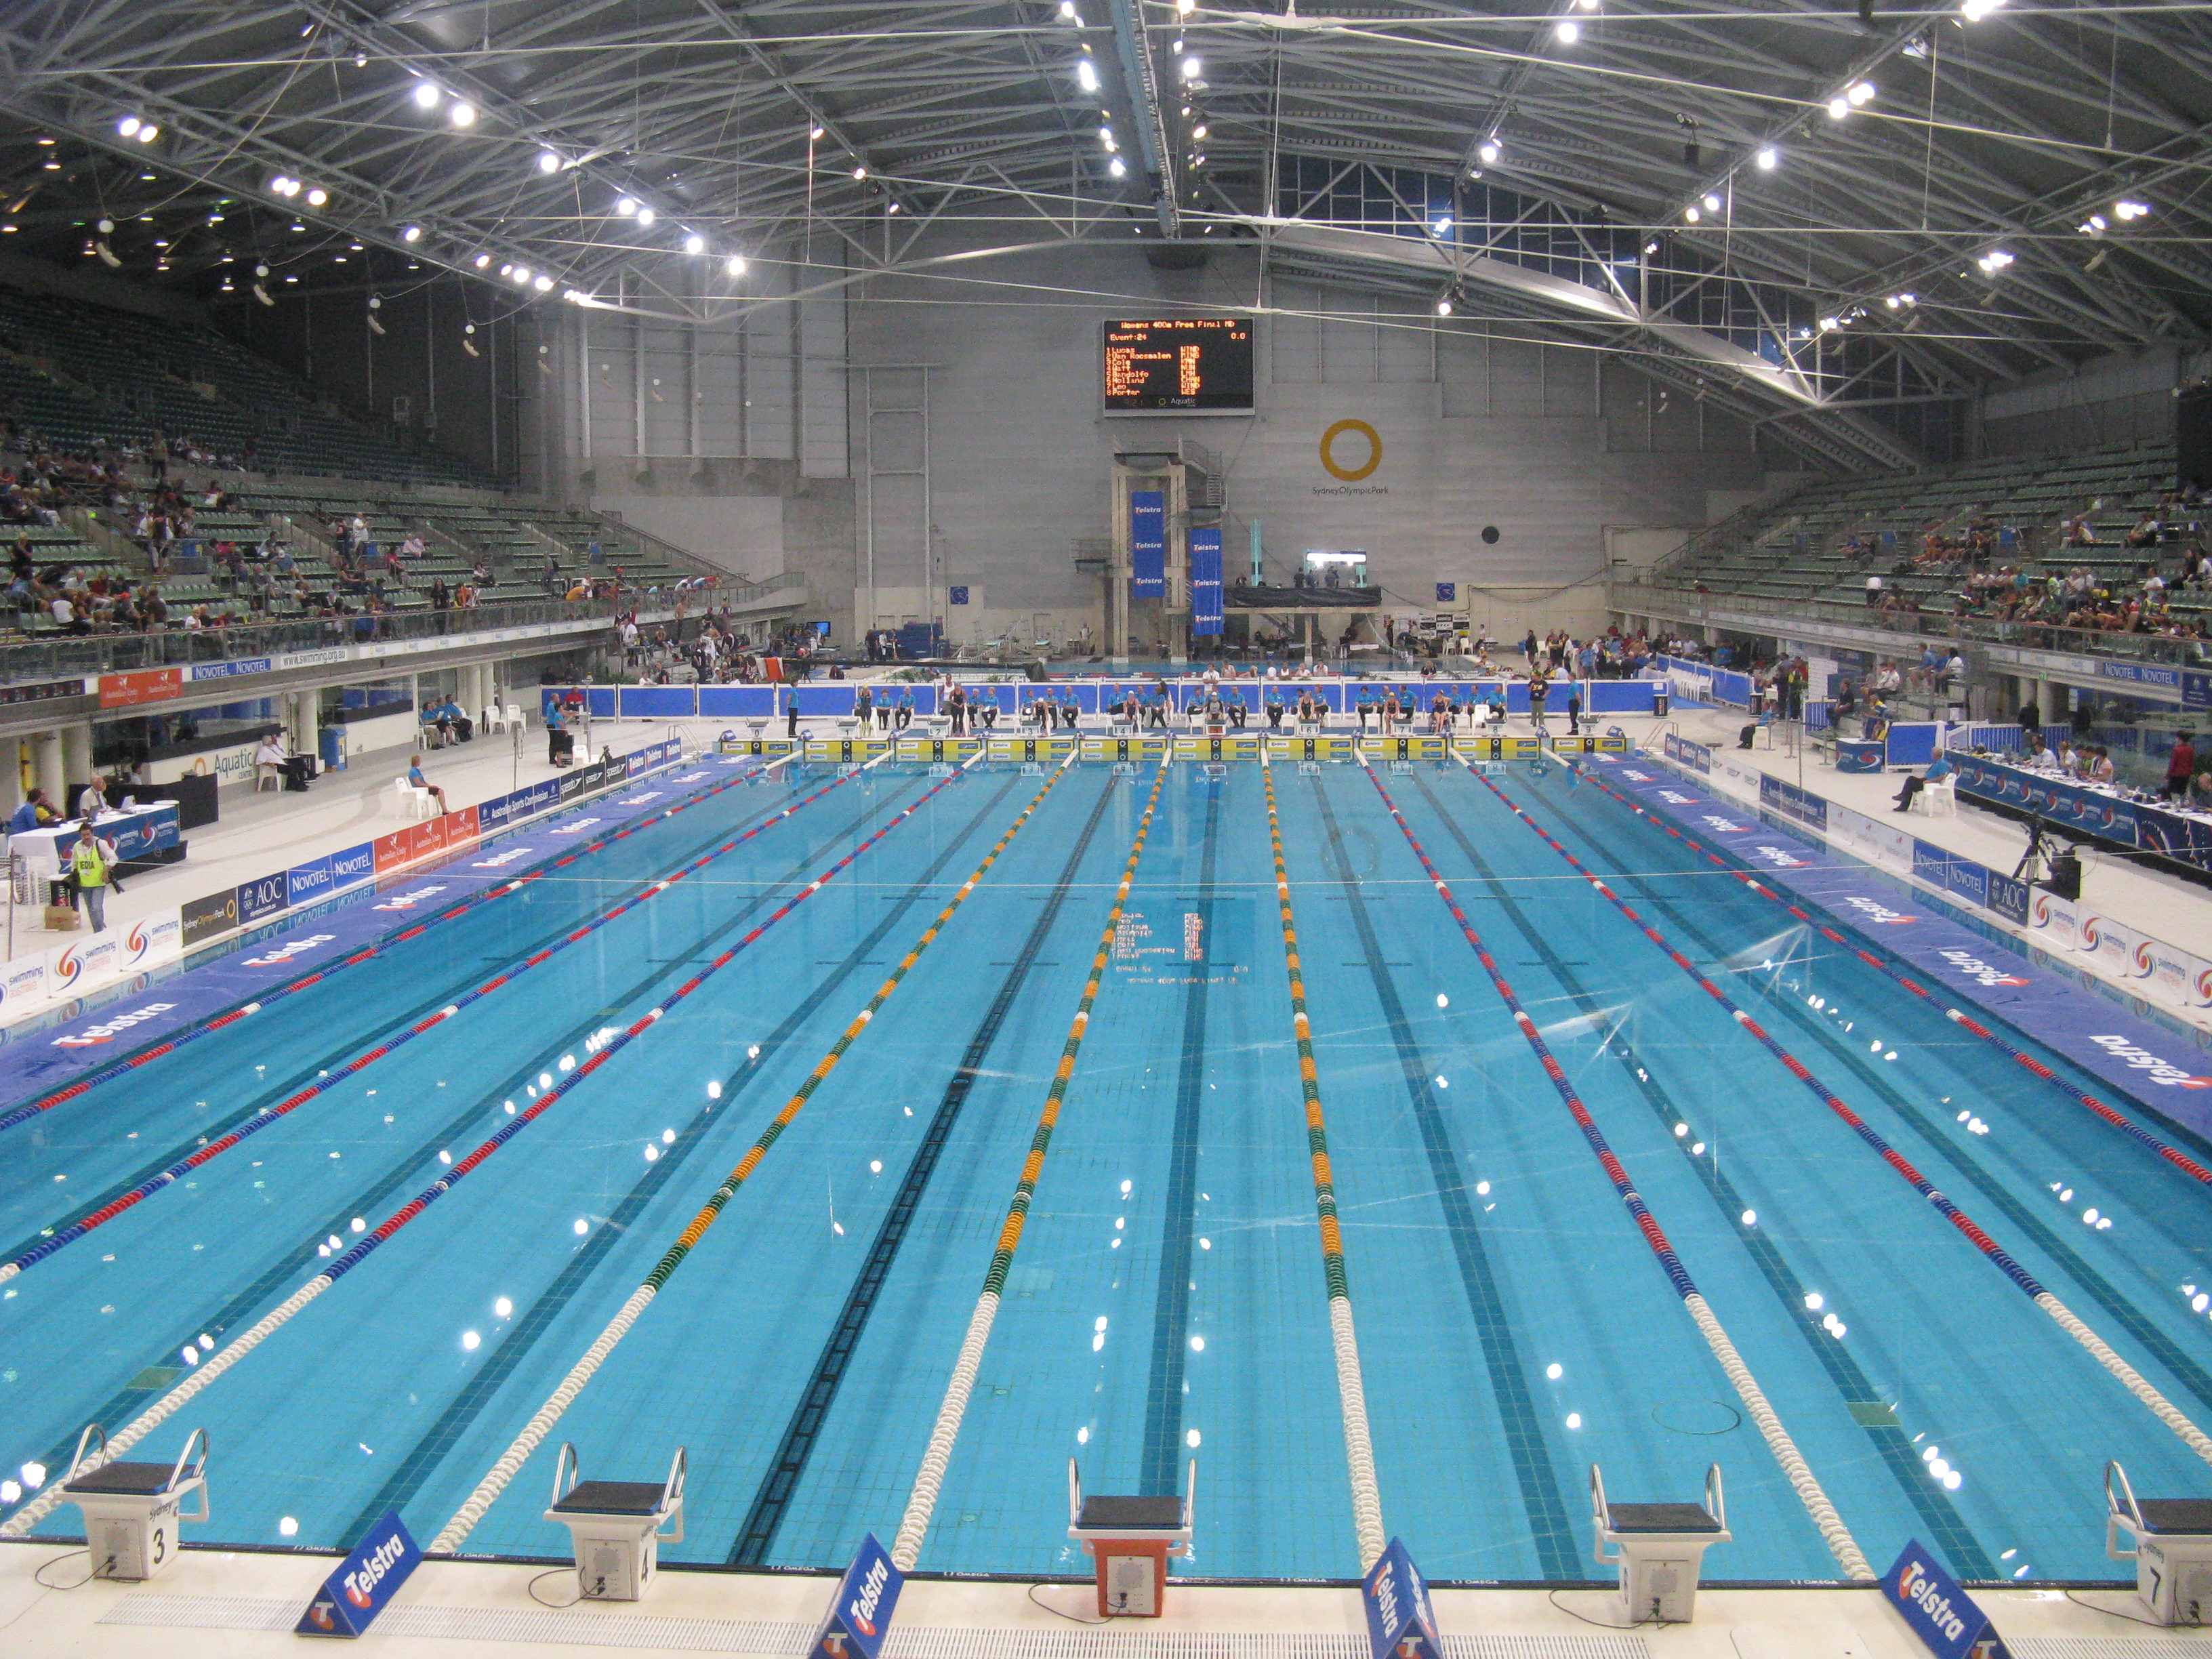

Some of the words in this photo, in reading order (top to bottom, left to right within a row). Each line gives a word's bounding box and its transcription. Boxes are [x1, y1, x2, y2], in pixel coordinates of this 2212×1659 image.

[194, 664, 229, 679] NOVOTEL
[236, 659, 268, 674] NOVOTEL
[2105, 663, 2135, 679] NOVOTEL
[2142, 668, 2174, 684] NOVOTEL
[214, 748, 252, 774] Aquatic
[335, 853, 371, 877] NOVOTEL
[1916, 850, 1945, 876] NOVOTEL
[256, 877, 282, 907] AOC
[292, 867, 329, 893] NOVOTEL
[1950, 864, 1984, 895] NOVOTEL
[2002, 883, 2025, 912] AOC
[152, 919, 179, 935] swimming
[85, 940, 116, 959] swimming
[9, 966, 44, 986] swimming
[50, 1003, 179, 1045] Telstra
[149, 1500, 173, 1522] Sydney
[153, 1528, 165, 1564] 3
[344, 1534, 405, 1603] Telstra
[640, 1548, 649, 1583] 4
[851, 1557, 889, 1631] Telstra
[2150, 1565, 2160, 1605] 7
[315, 1601, 334, 1622] T
[1376, 1560, 1399, 1639] Telstra
[1902, 1561, 1965, 1641] Telstra
[827, 1632, 848, 1653] T
[1402, 1636, 1423, 1658] T
